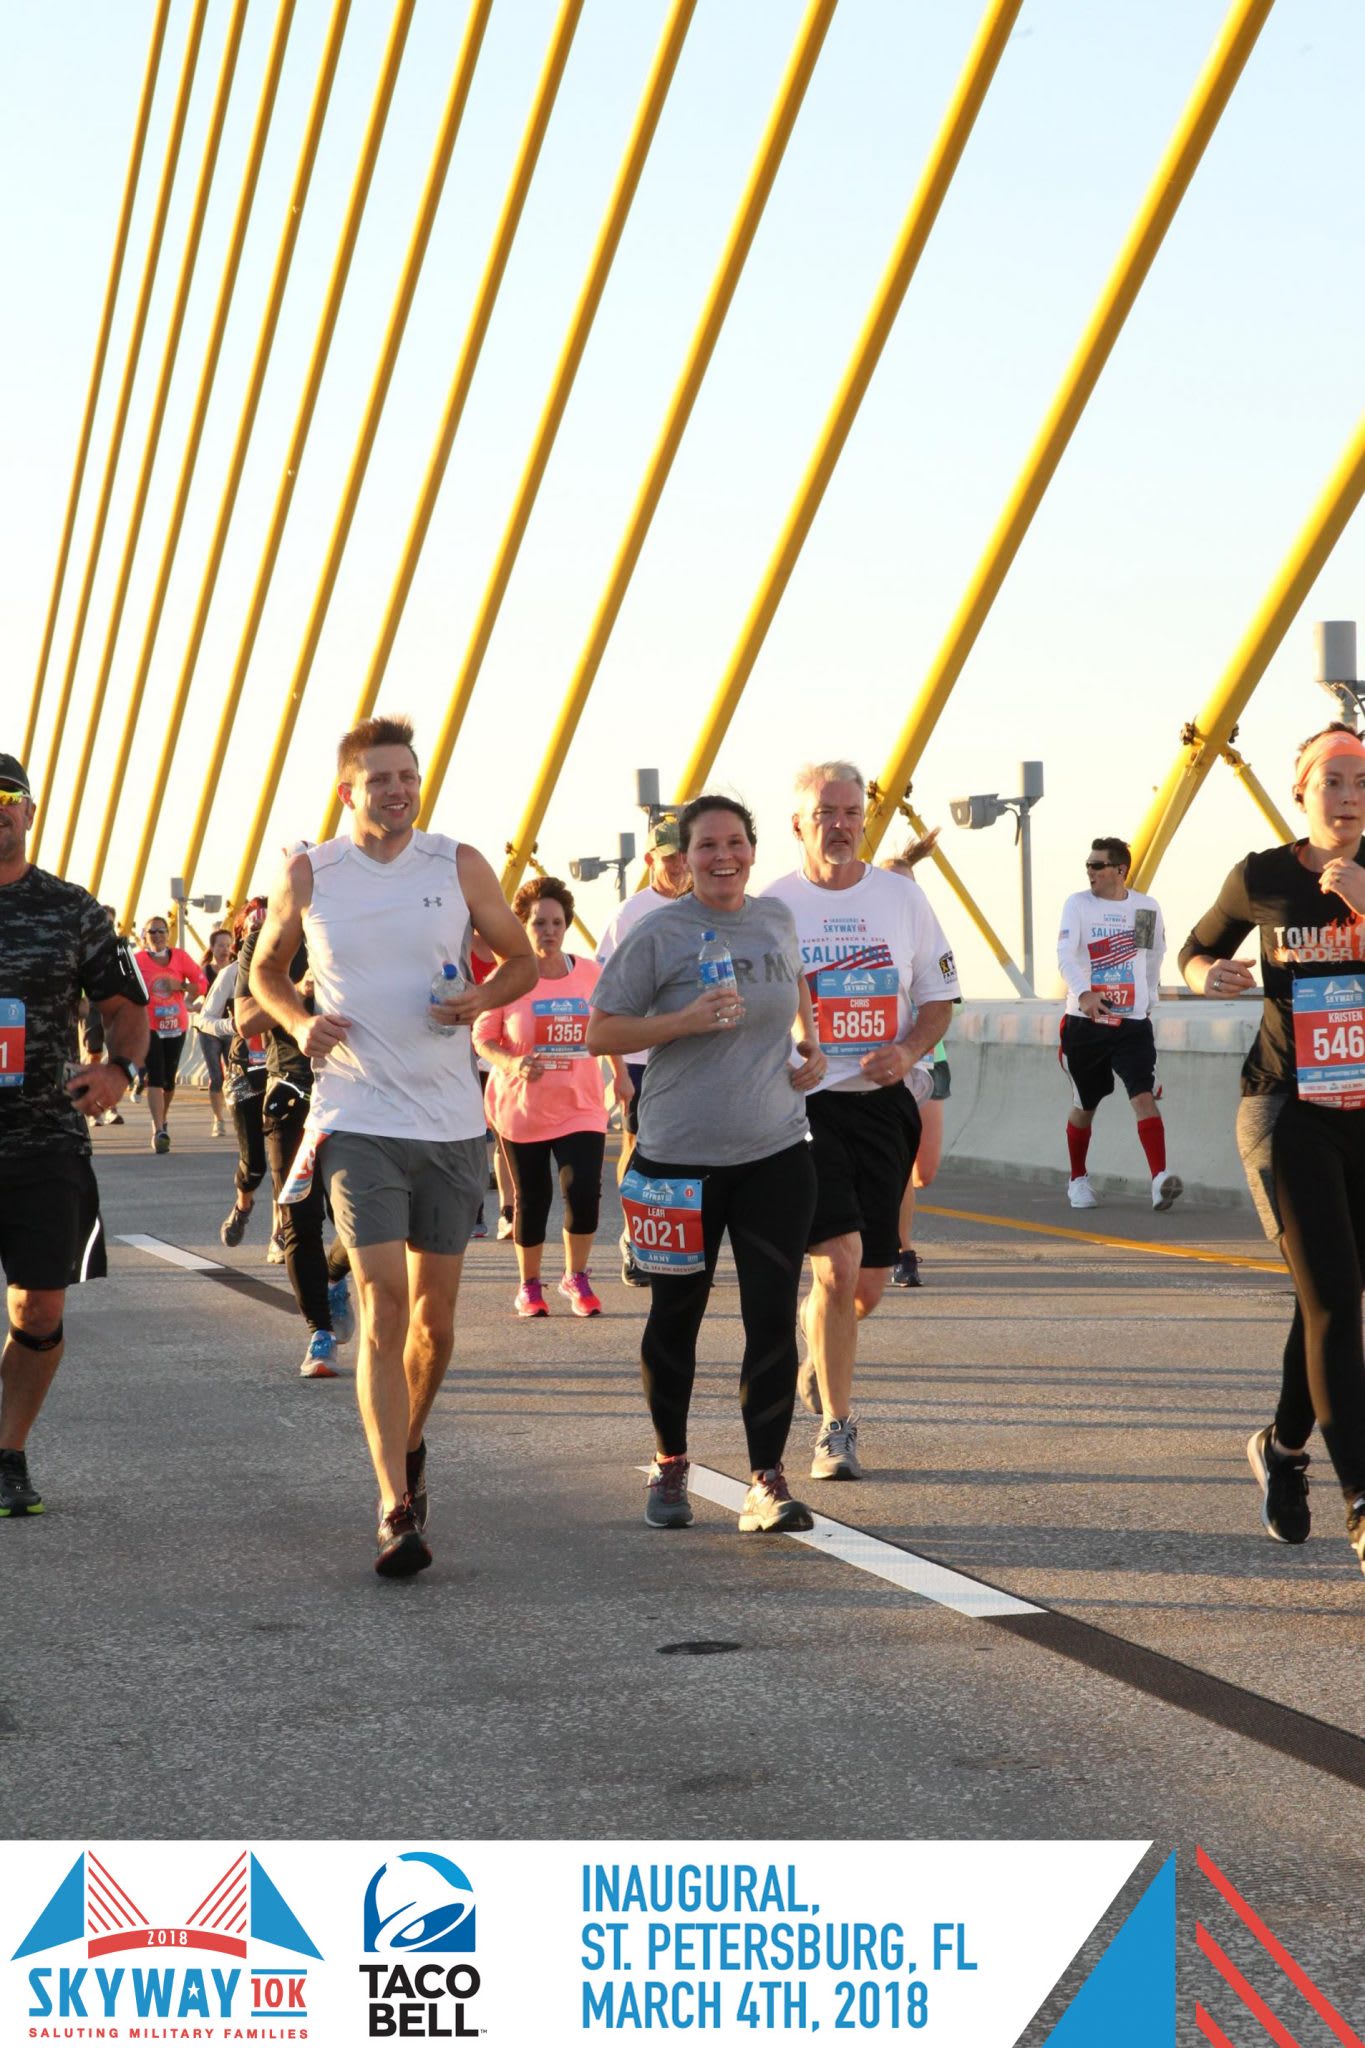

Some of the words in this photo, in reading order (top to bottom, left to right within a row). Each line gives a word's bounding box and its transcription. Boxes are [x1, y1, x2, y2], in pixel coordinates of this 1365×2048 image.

[823, 924, 856, 932] SKYWAY
[1274, 926, 1351, 948] TOUGH
[801, 945, 891, 963] SALUTING
[850, 999, 870, 1008] CHRIS
[1106, 990, 1129, 1005] 337
[833, 1010, 885, 1038] 5855
[1328, 1011, 1363, 1023] KRISTEN
[547, 1024, 583, 1042] 1355
[632, 1216, 685, 1248] 2021
[648, 1252, 670, 1262] ARMY
